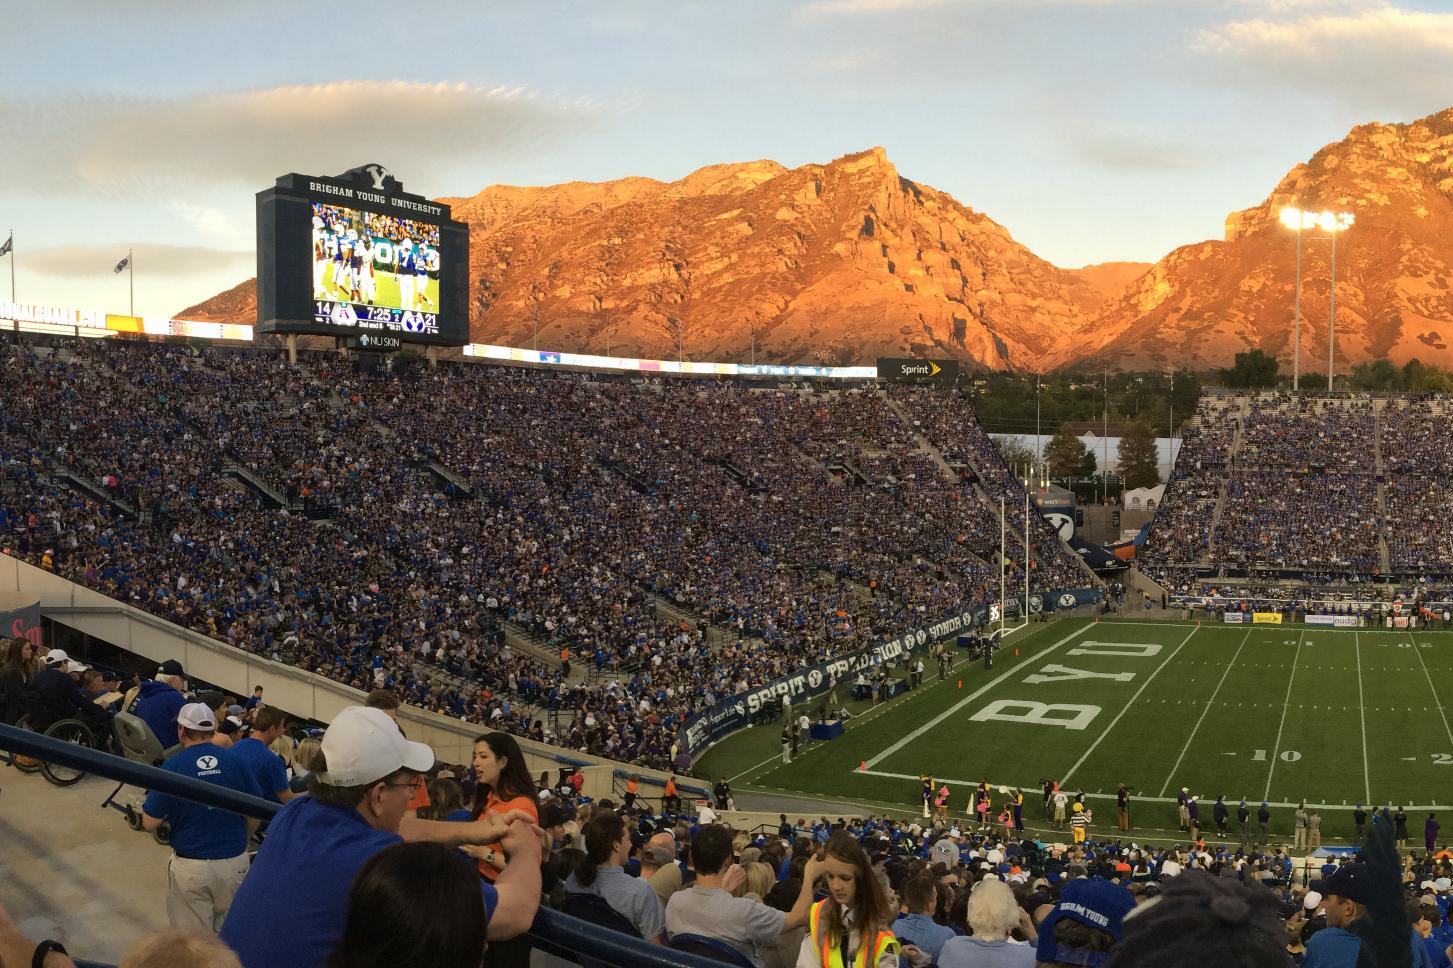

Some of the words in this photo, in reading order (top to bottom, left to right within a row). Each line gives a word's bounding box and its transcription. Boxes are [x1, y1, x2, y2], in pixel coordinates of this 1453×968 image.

[309, 181, 353, 198] BRIGHAM
[357, 190, 386, 204] YOUNG
[391, 197, 442, 216] UNIVERSITY
[316, 301, 331, 314] 14
[367, 306, 391, 321] 7:25
[425, 313, 436, 326] 21
[384, 337, 399, 347] SKIN
[901, 364, 928, 376] Sprint
[968, 640, 1163, 730] BYU
[1250, 748, 1302, 762] 10
[197, 769, 222, 777] FOOTBALL
[1085, 908, 1109, 927] YOUNG
